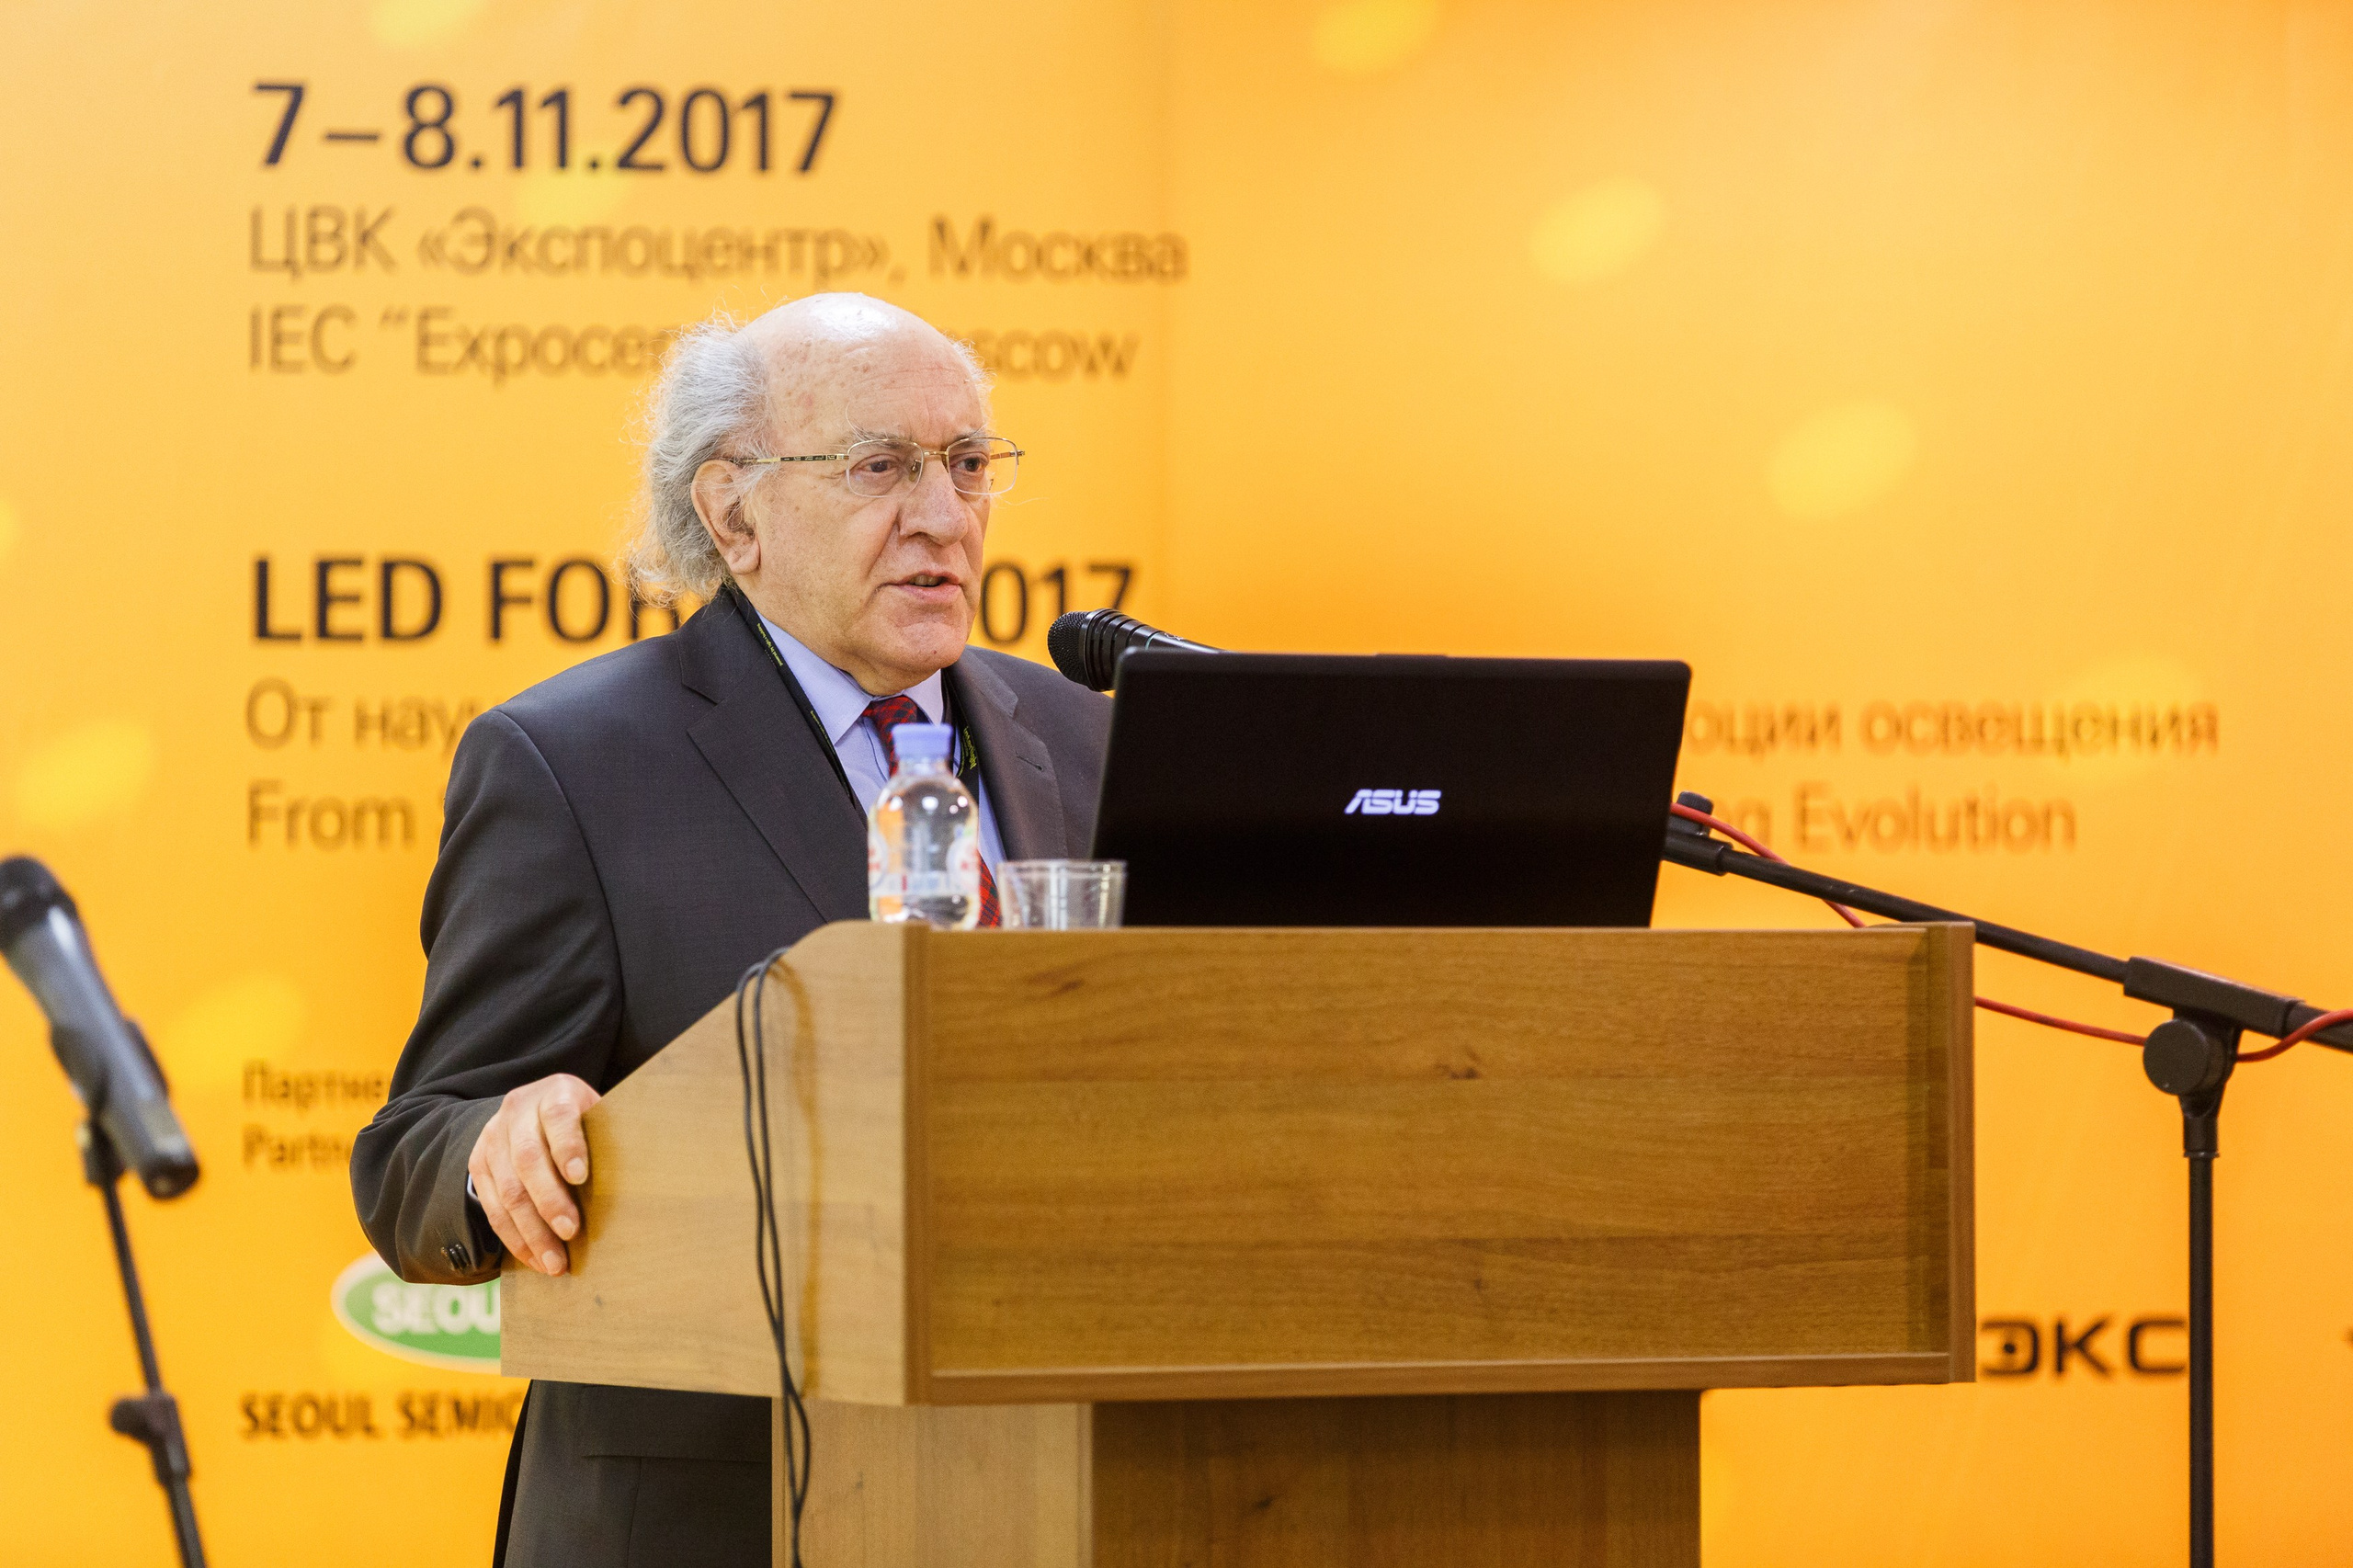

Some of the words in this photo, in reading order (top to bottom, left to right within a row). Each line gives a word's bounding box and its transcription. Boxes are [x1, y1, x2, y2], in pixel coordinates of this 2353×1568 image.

[248, 206, 399, 283] ЦВК
[418, 206, 908, 292] «Экспоцентр»,
[926, 215, 1191, 283] Москва
[249, 303, 358, 375] IEC
[256, 557, 445, 642] LED
[981, 560, 1134, 645] 017
[244, 676, 331, 750] От
[353, 696, 484, 761] нау
[1859, 700, 2221, 765] освещения
[246, 779, 415, 849] From
[1344, 789, 1442, 815] ASUS
[1792, 781, 2077, 853] Evolution
[241, 1392, 378, 1439] SEOUL
